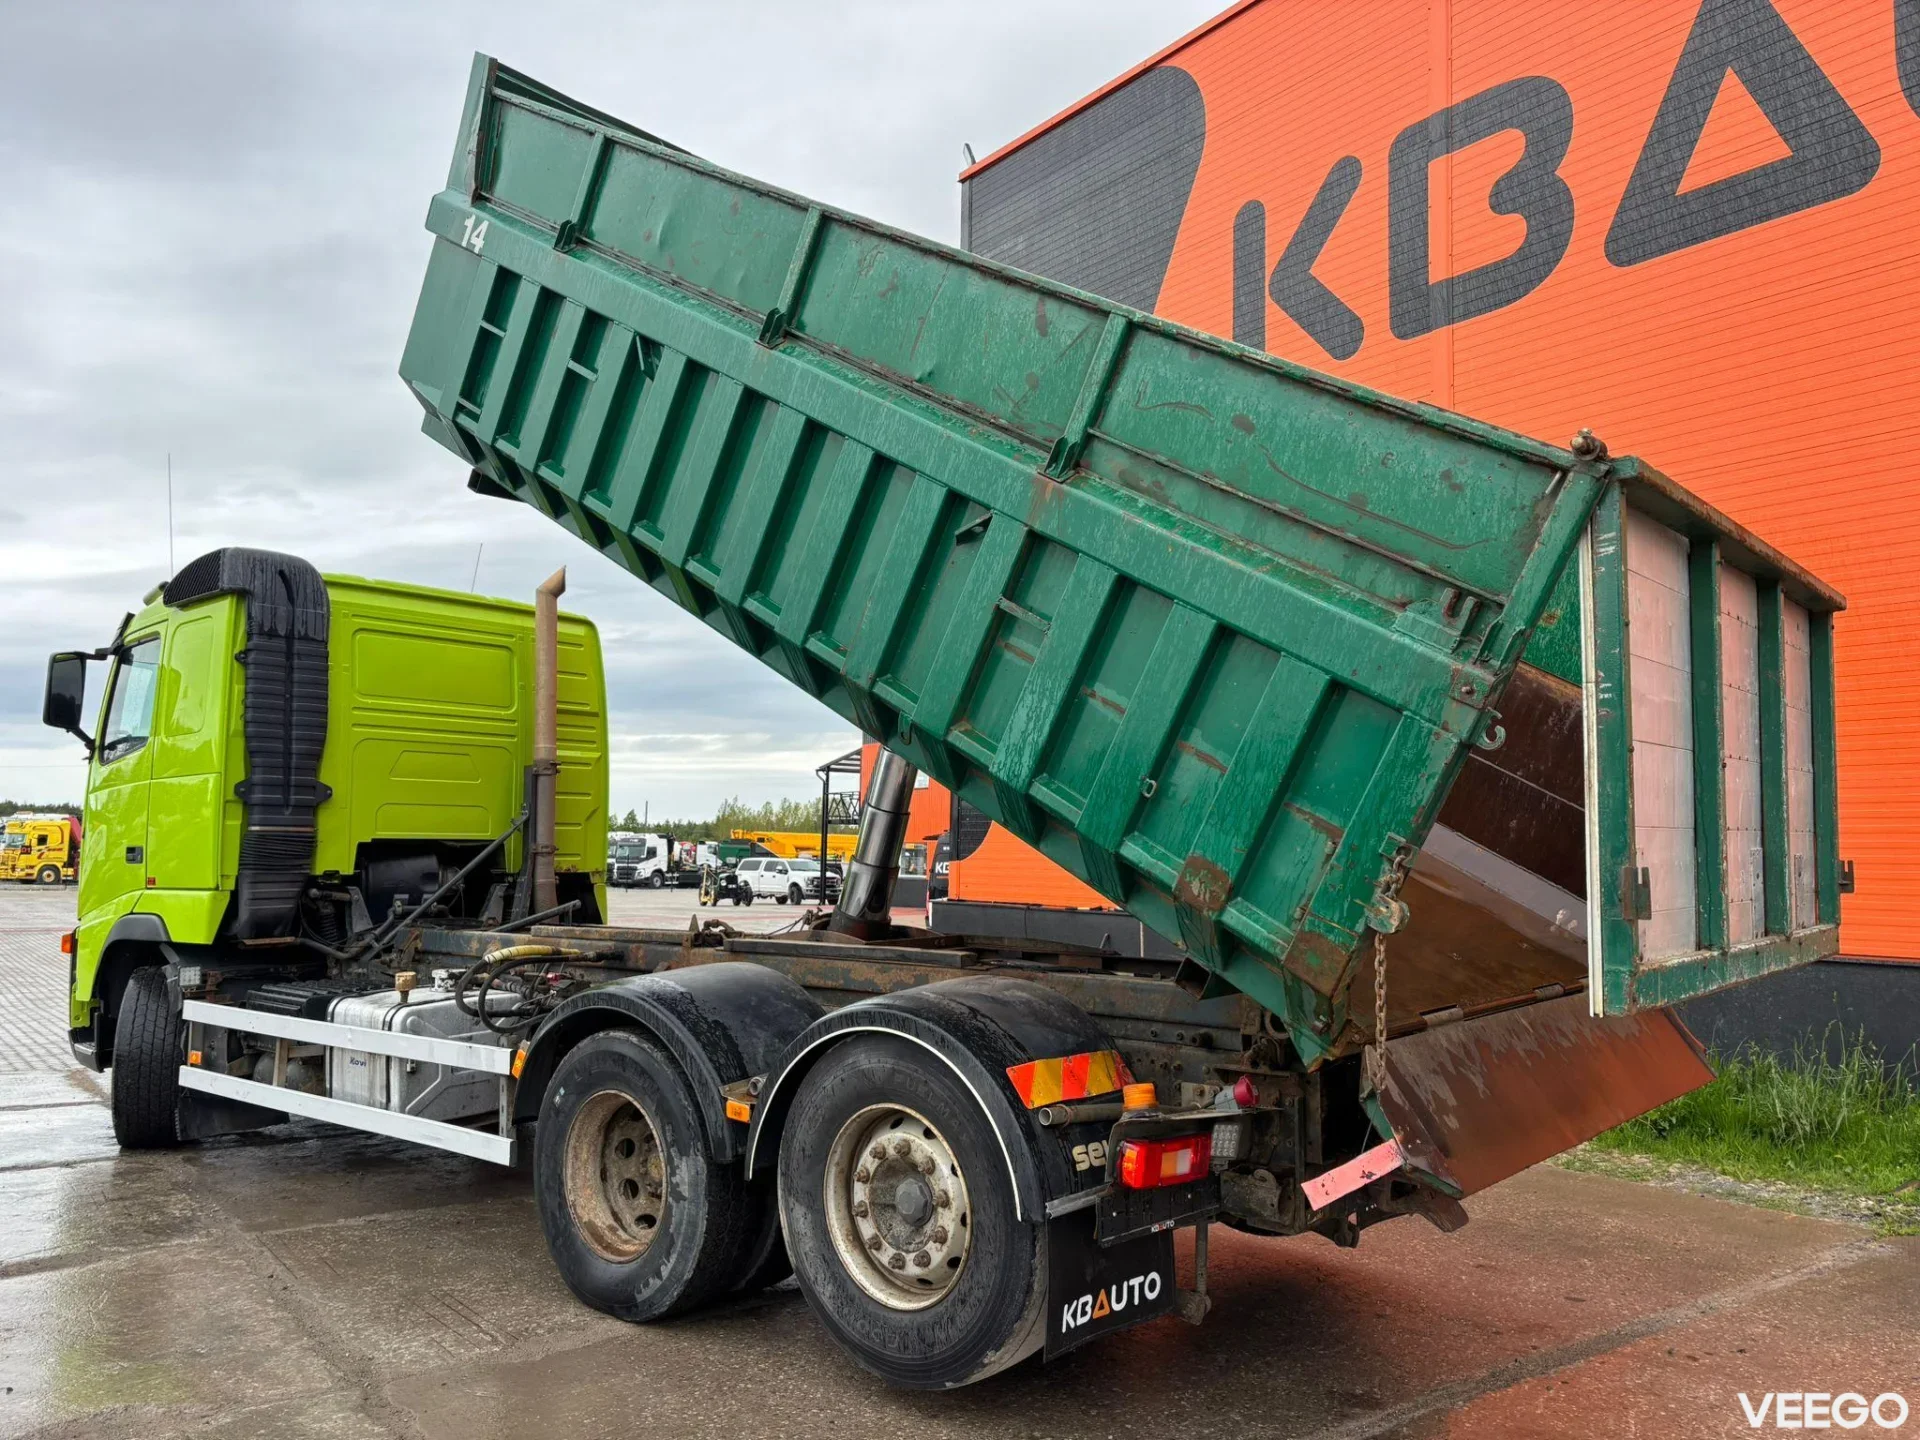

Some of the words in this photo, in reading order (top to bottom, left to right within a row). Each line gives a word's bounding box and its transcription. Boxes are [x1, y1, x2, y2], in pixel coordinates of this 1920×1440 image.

[1233, 0, 1920, 361] KBA
[462, 214, 489, 254] 14
[1062, 1271, 1161, 1334] KBAUTO
